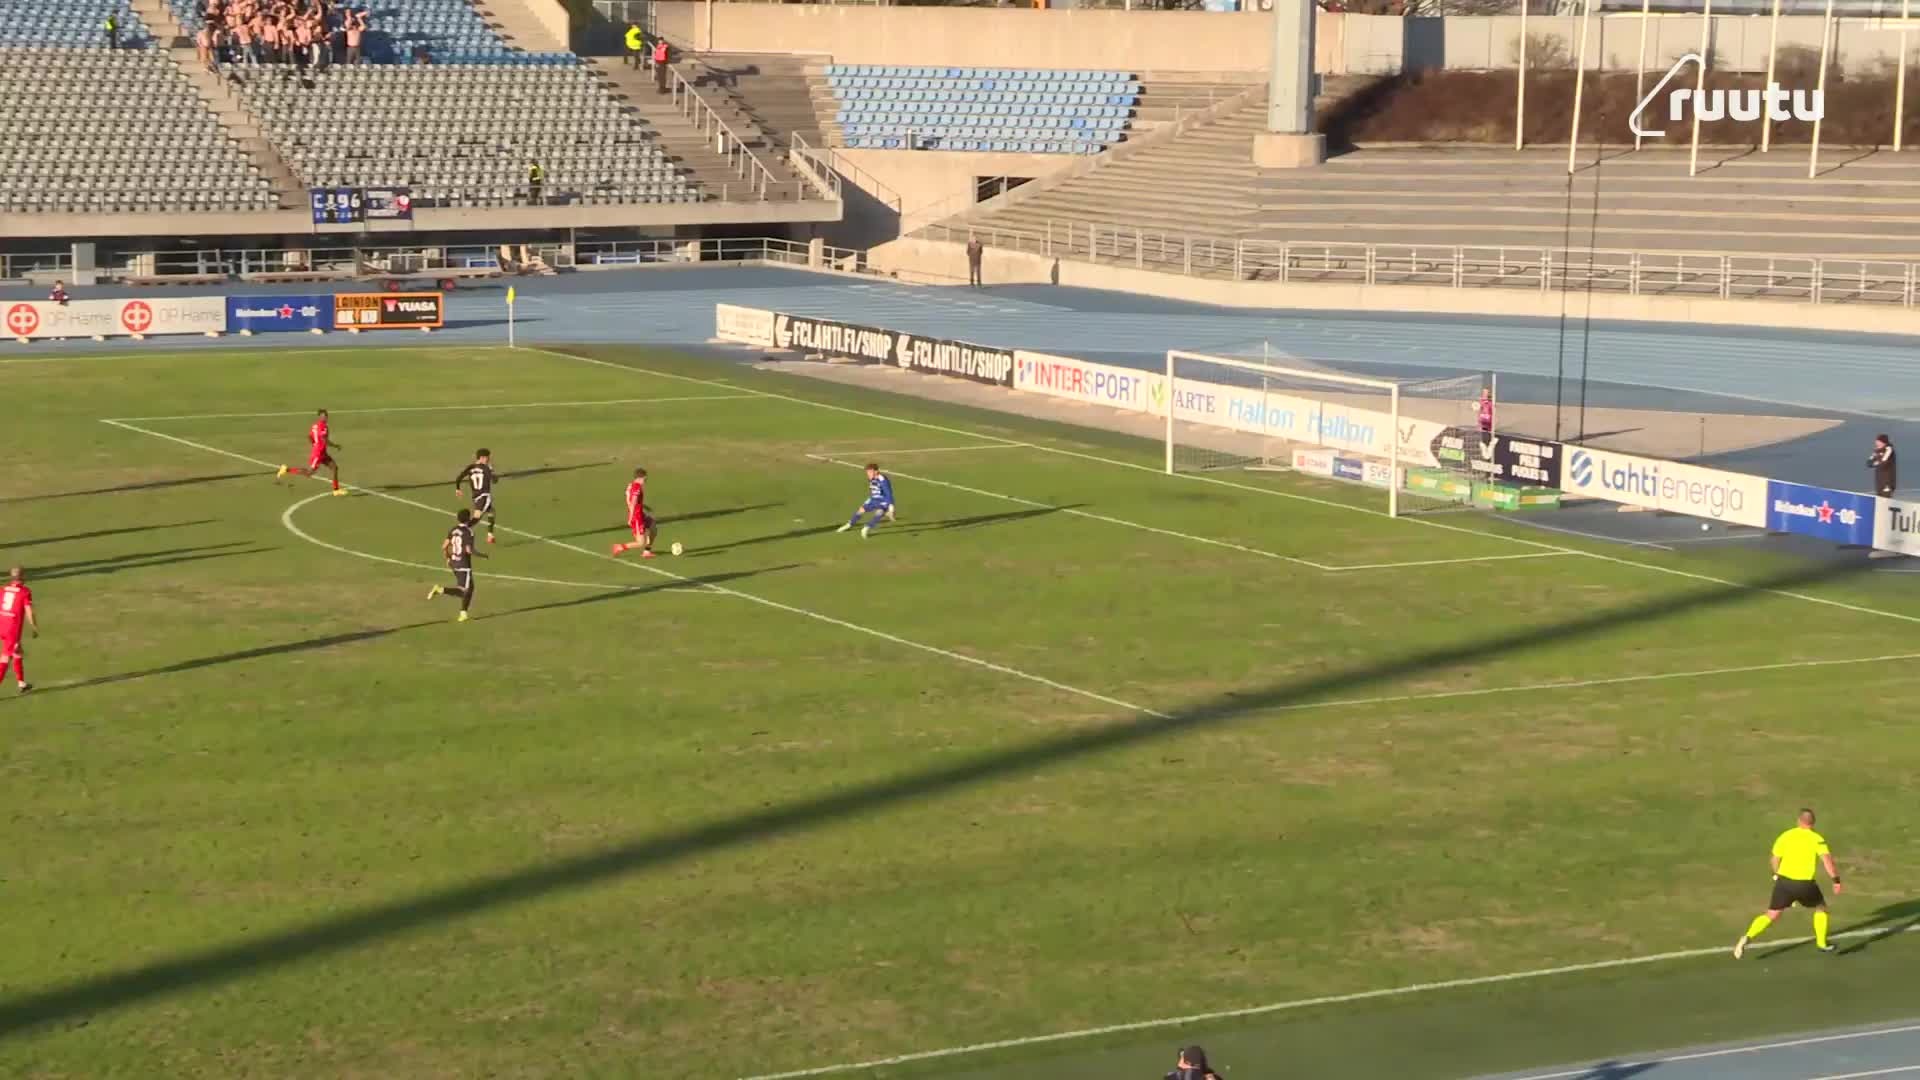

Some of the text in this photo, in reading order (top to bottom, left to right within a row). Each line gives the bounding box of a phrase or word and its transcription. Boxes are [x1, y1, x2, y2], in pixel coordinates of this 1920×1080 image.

[397, 301, 437, 312] YUASA
[1033, 361, 1140, 403] INTERSPORT
[1172, 387, 1216, 413] ARTE
[1600, 459, 1658, 497] Lahti
[1662, 475, 1745, 518] energia
